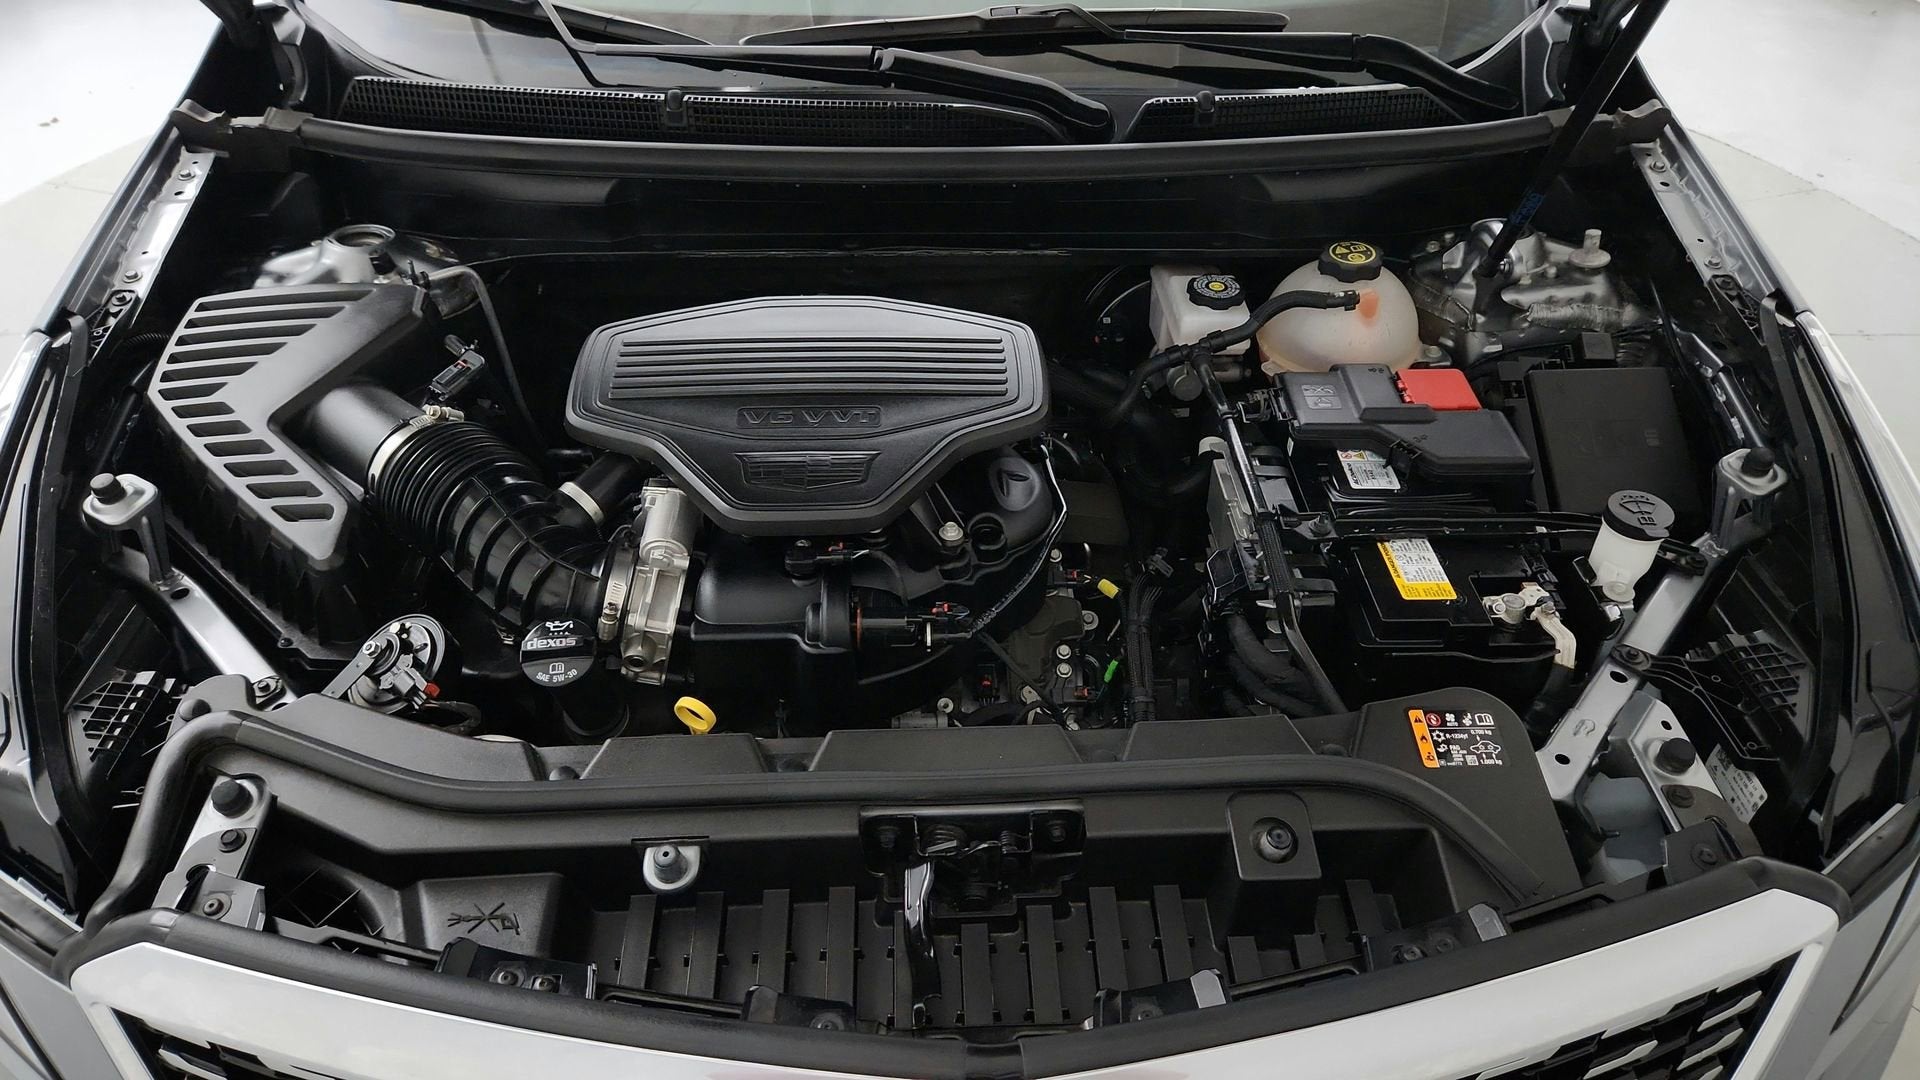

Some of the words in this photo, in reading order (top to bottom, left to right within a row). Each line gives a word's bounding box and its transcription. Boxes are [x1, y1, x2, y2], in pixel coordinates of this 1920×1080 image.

[743, 410, 793, 424] V6
[801, 410, 877, 424] VVT
[527, 638, 577, 649] dexos
[536, 671, 551, 682] SAE
[552, 668, 578, 683] 5W-30
